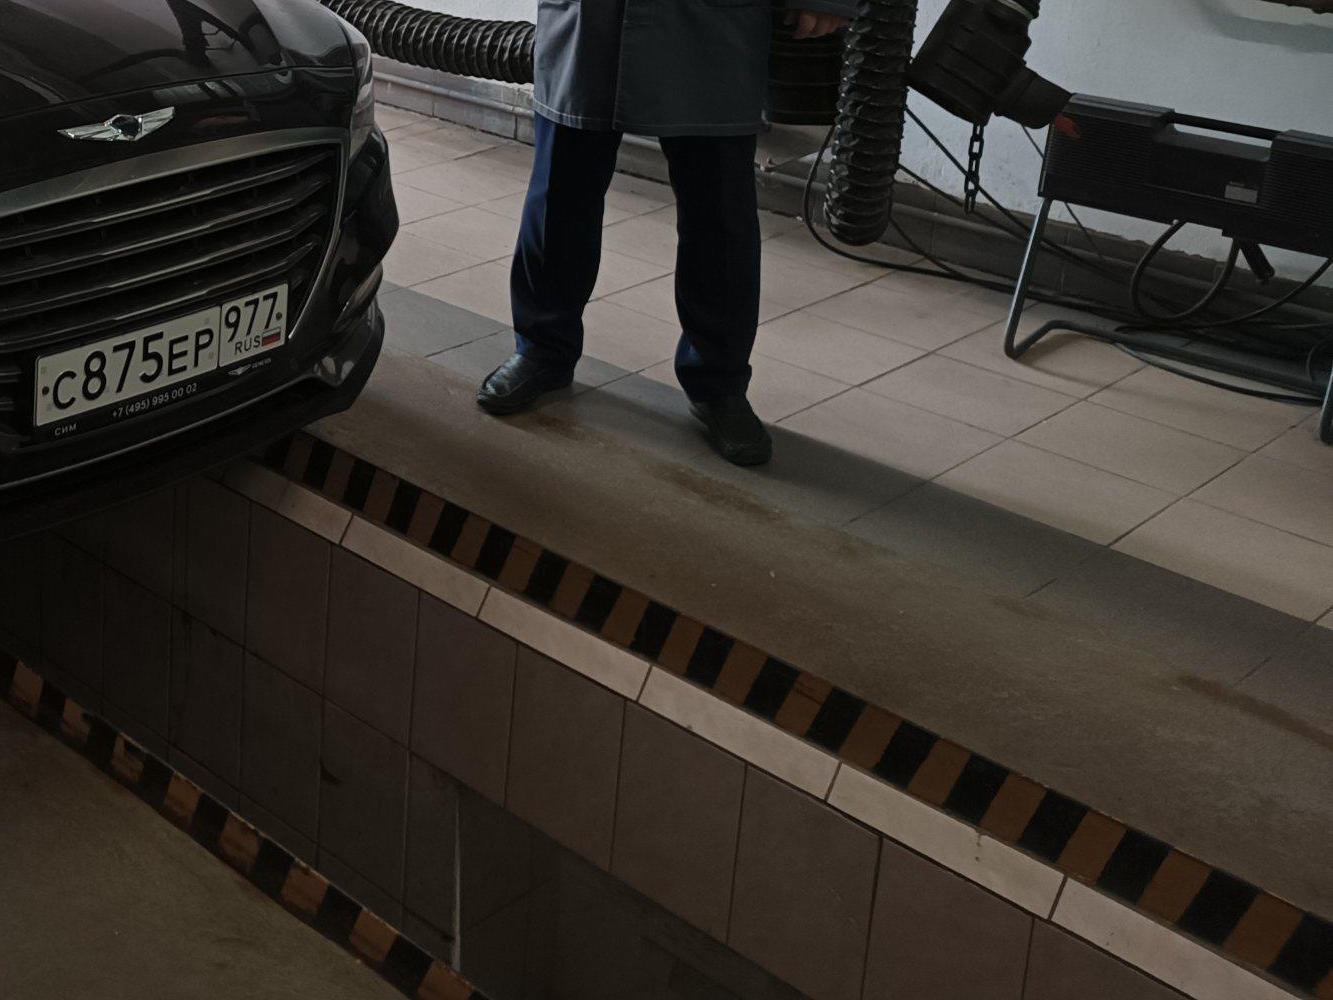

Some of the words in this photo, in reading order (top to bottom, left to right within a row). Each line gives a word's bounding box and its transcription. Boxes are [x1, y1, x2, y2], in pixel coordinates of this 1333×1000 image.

[52, 328, 214, 410] С875ЕР
[224, 291, 279, 342] 977
[234, 335, 261, 355] RUS
[112, 407, 123, 418] +7
[125, 398, 150, 416] (495)
[171, 387, 184, 400] 00
[186, 382, 198, 394] 02
